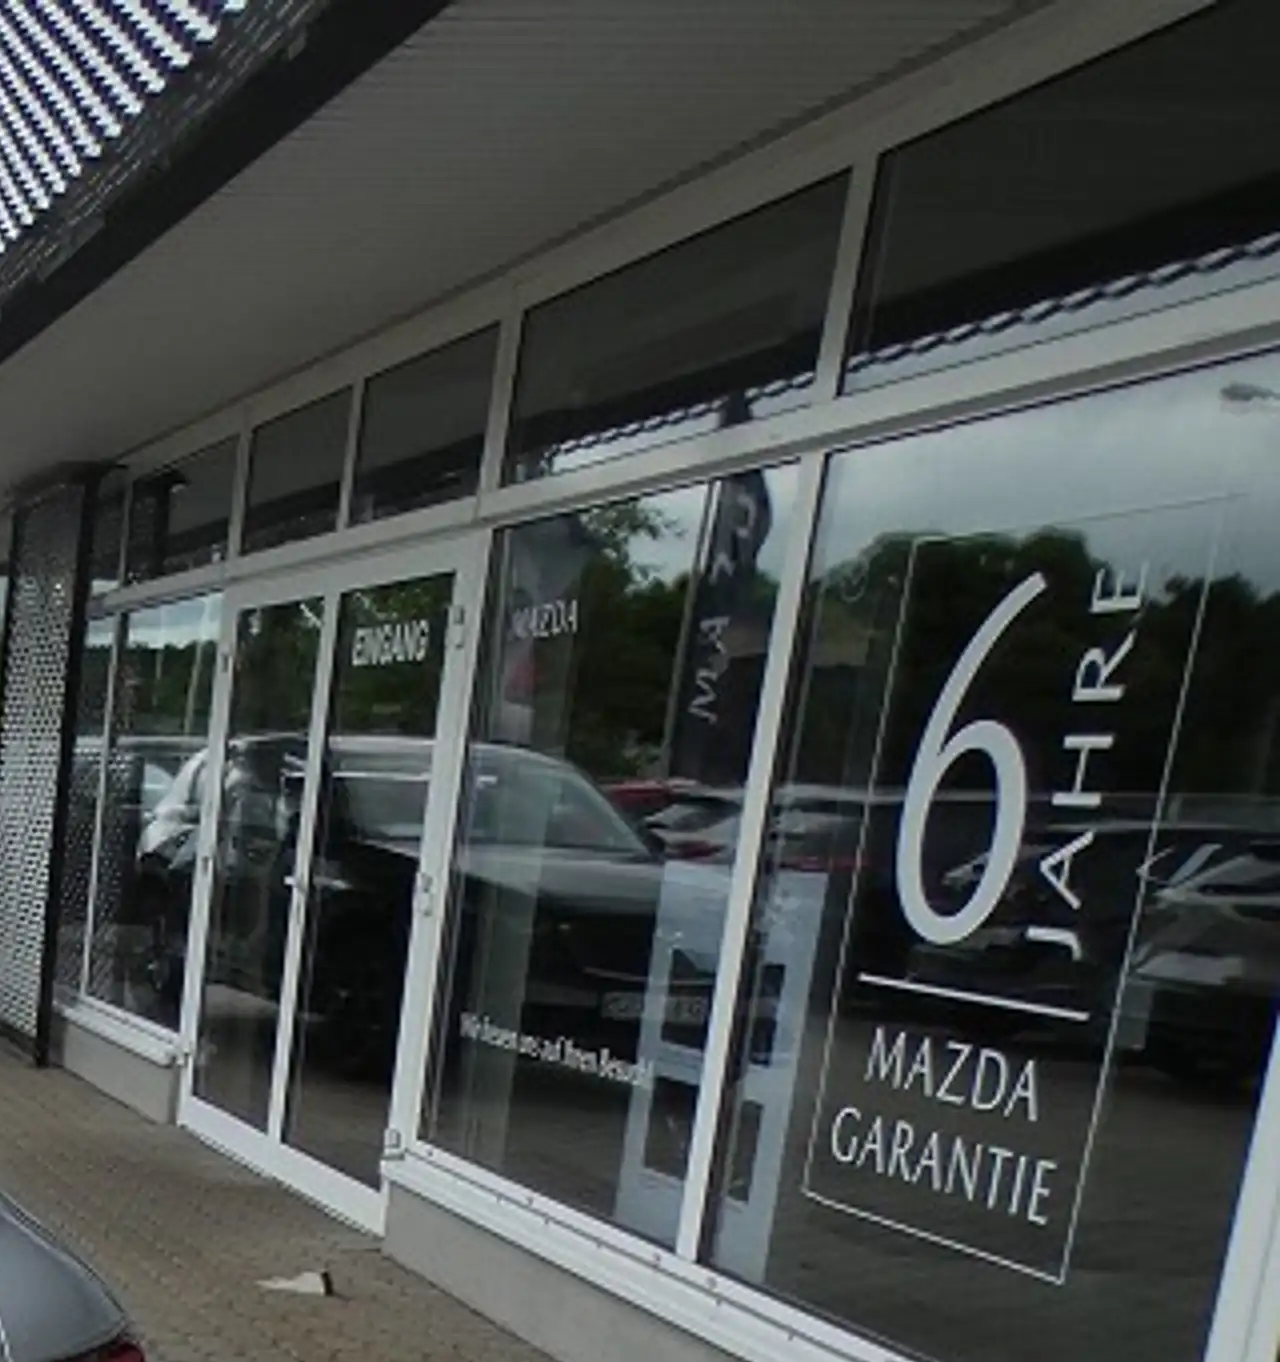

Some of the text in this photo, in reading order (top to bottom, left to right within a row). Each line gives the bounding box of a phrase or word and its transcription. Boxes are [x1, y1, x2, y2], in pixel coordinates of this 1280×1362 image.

[351, 619, 430, 667] EINGANG
[895, 570, 1048, 946] 6
[1025, 562, 1151, 962] JAHRE
[863, 1026, 1039, 1123] MAZDA
[830, 1106, 1059, 1226] GARANTIE
